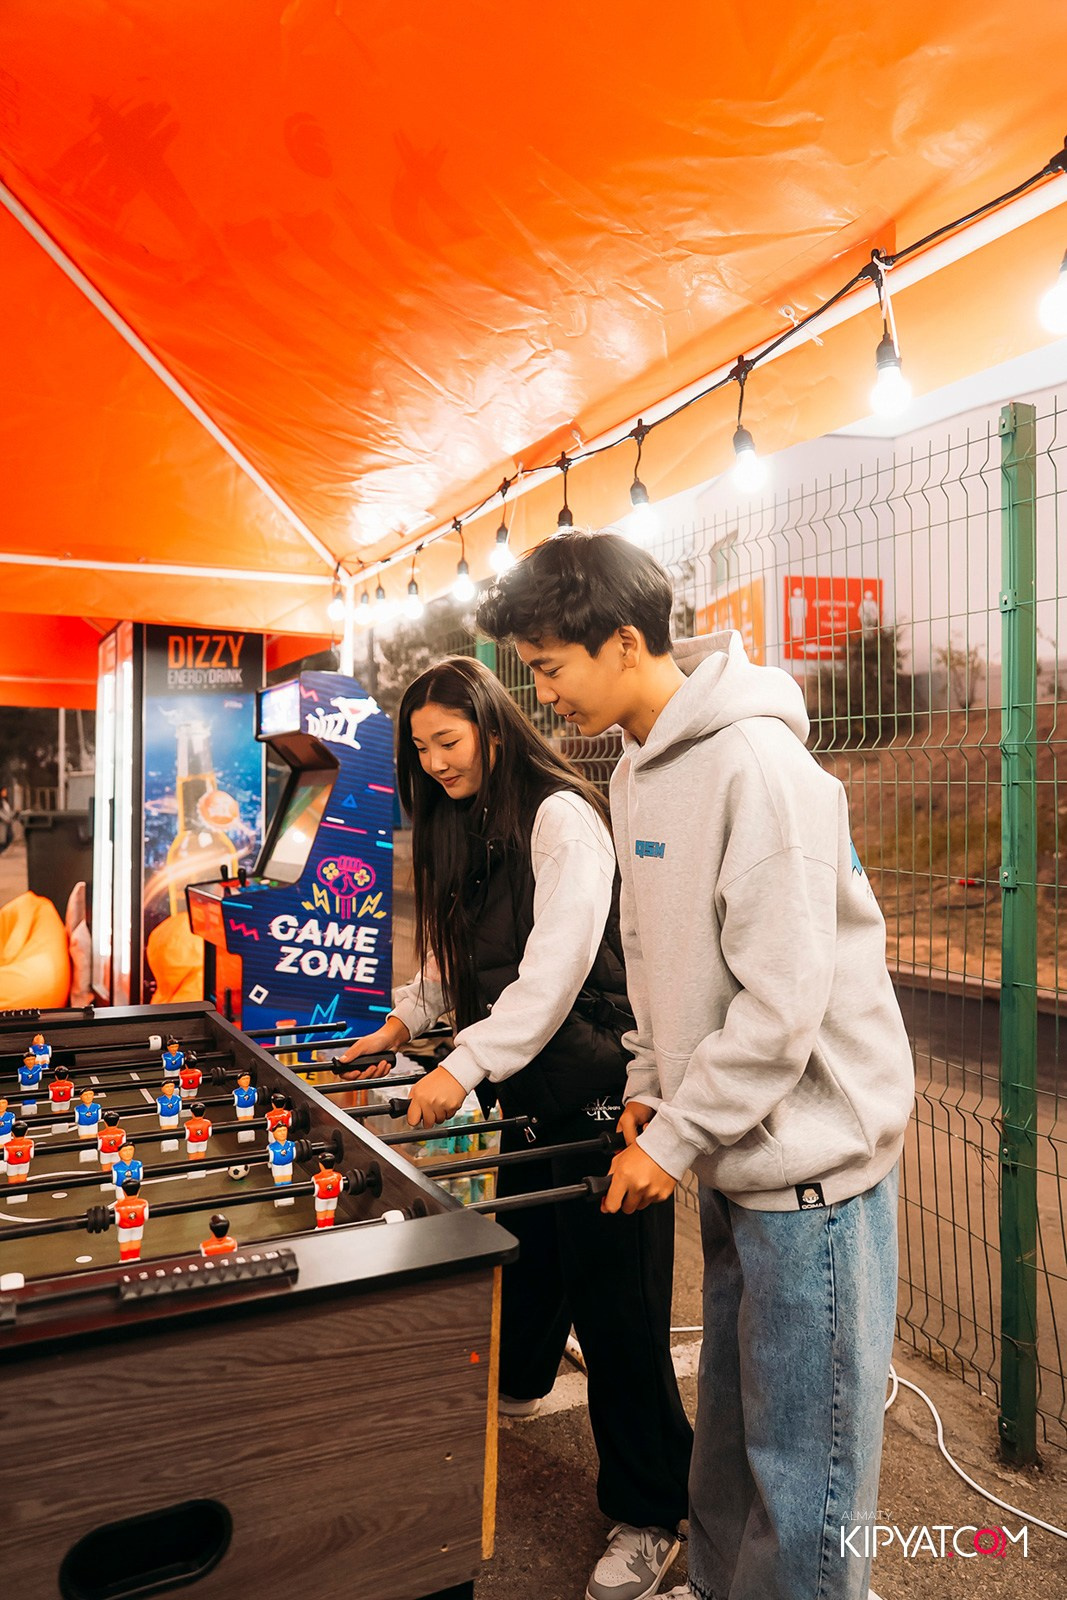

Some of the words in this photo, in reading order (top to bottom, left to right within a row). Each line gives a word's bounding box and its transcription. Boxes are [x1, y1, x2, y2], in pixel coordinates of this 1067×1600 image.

[167, 635, 245, 669] DIZZY
[267, 914, 379, 953] GAME
[275, 946, 379, 983] ZONE
